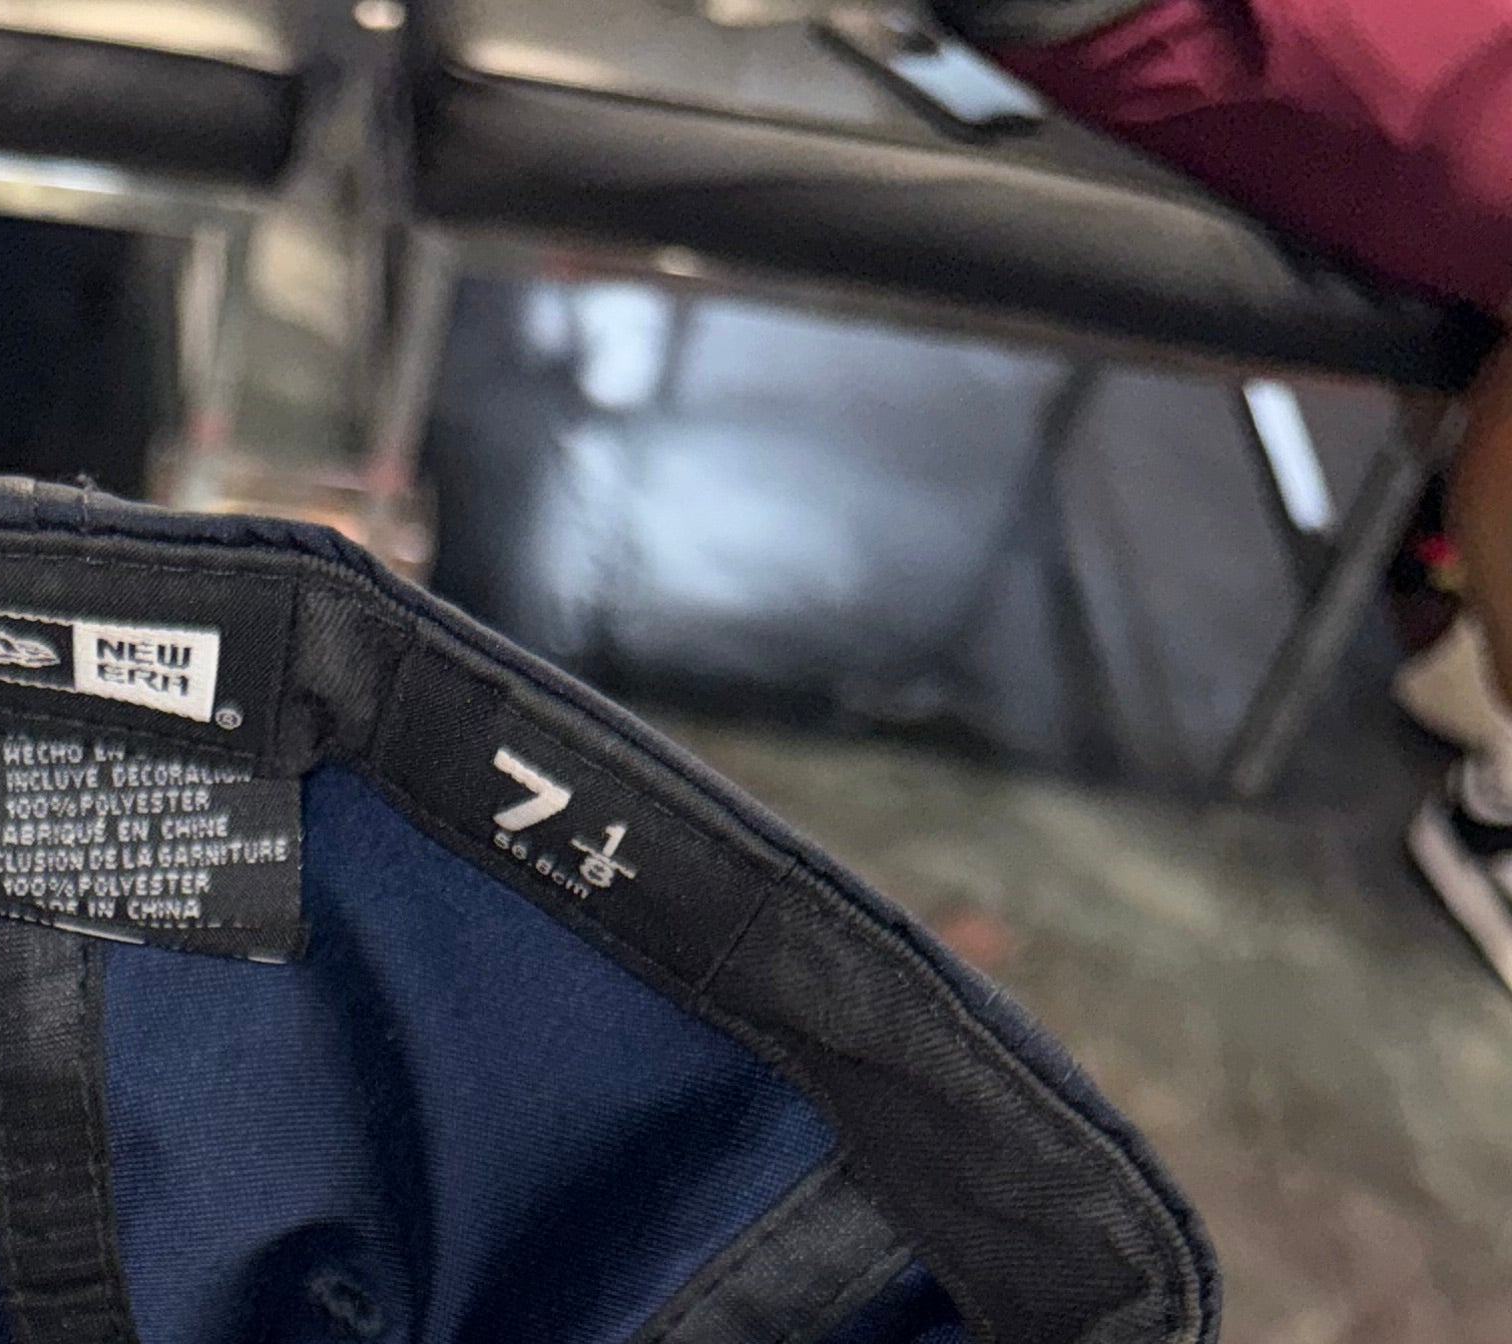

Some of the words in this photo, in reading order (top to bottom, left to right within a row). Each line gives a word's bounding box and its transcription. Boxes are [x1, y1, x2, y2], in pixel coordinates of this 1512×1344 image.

[96, 637, 192, 670] NEW
[97, 663, 190, 697] ERA
[3, 740, 83, 765] HECHO
[492, 748, 572, 832] 7
[117, 817, 150, 842] EN
[161, 813, 229, 840] CHINE
[89, 846, 118, 870] DE
[122, 846, 153, 869] LA
[157, 838, 287, 868] GARNITURE
[88, 898, 116, 918] IN
[126, 896, 200, 919] CHINA
